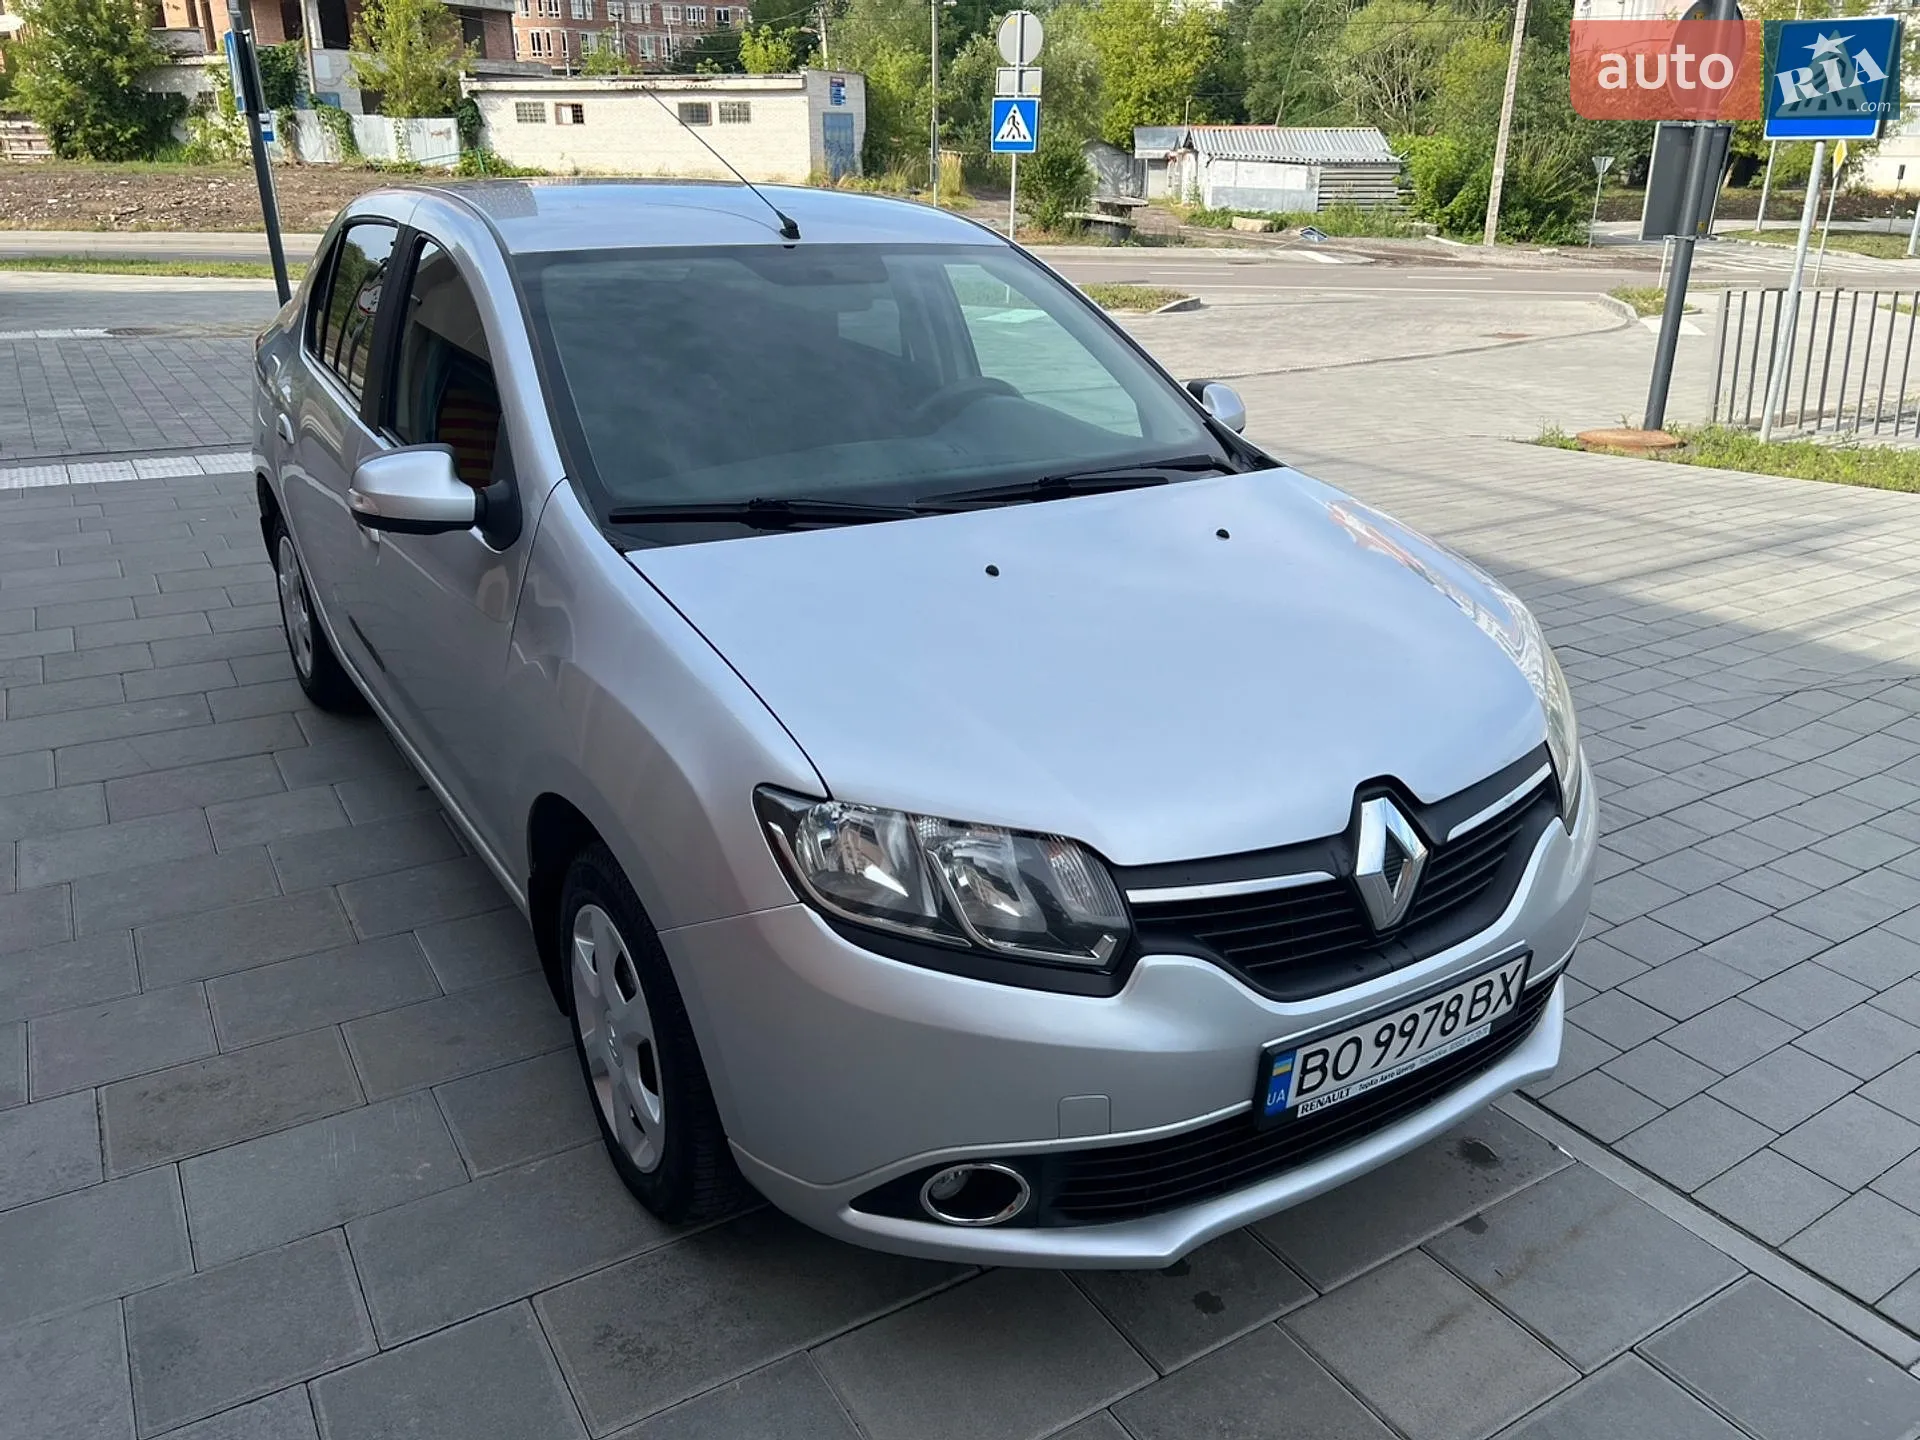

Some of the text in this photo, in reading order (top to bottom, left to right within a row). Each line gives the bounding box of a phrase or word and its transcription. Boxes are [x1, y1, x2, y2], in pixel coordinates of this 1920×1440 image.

[1296, 1036, 1363, 1098] BO
[1370, 993, 1464, 1069] 9978
[1465, 963, 1522, 1027] BX
[1266, 1088, 1286, 1106] UA
[1300, 1087, 1352, 1114] RENAULT
